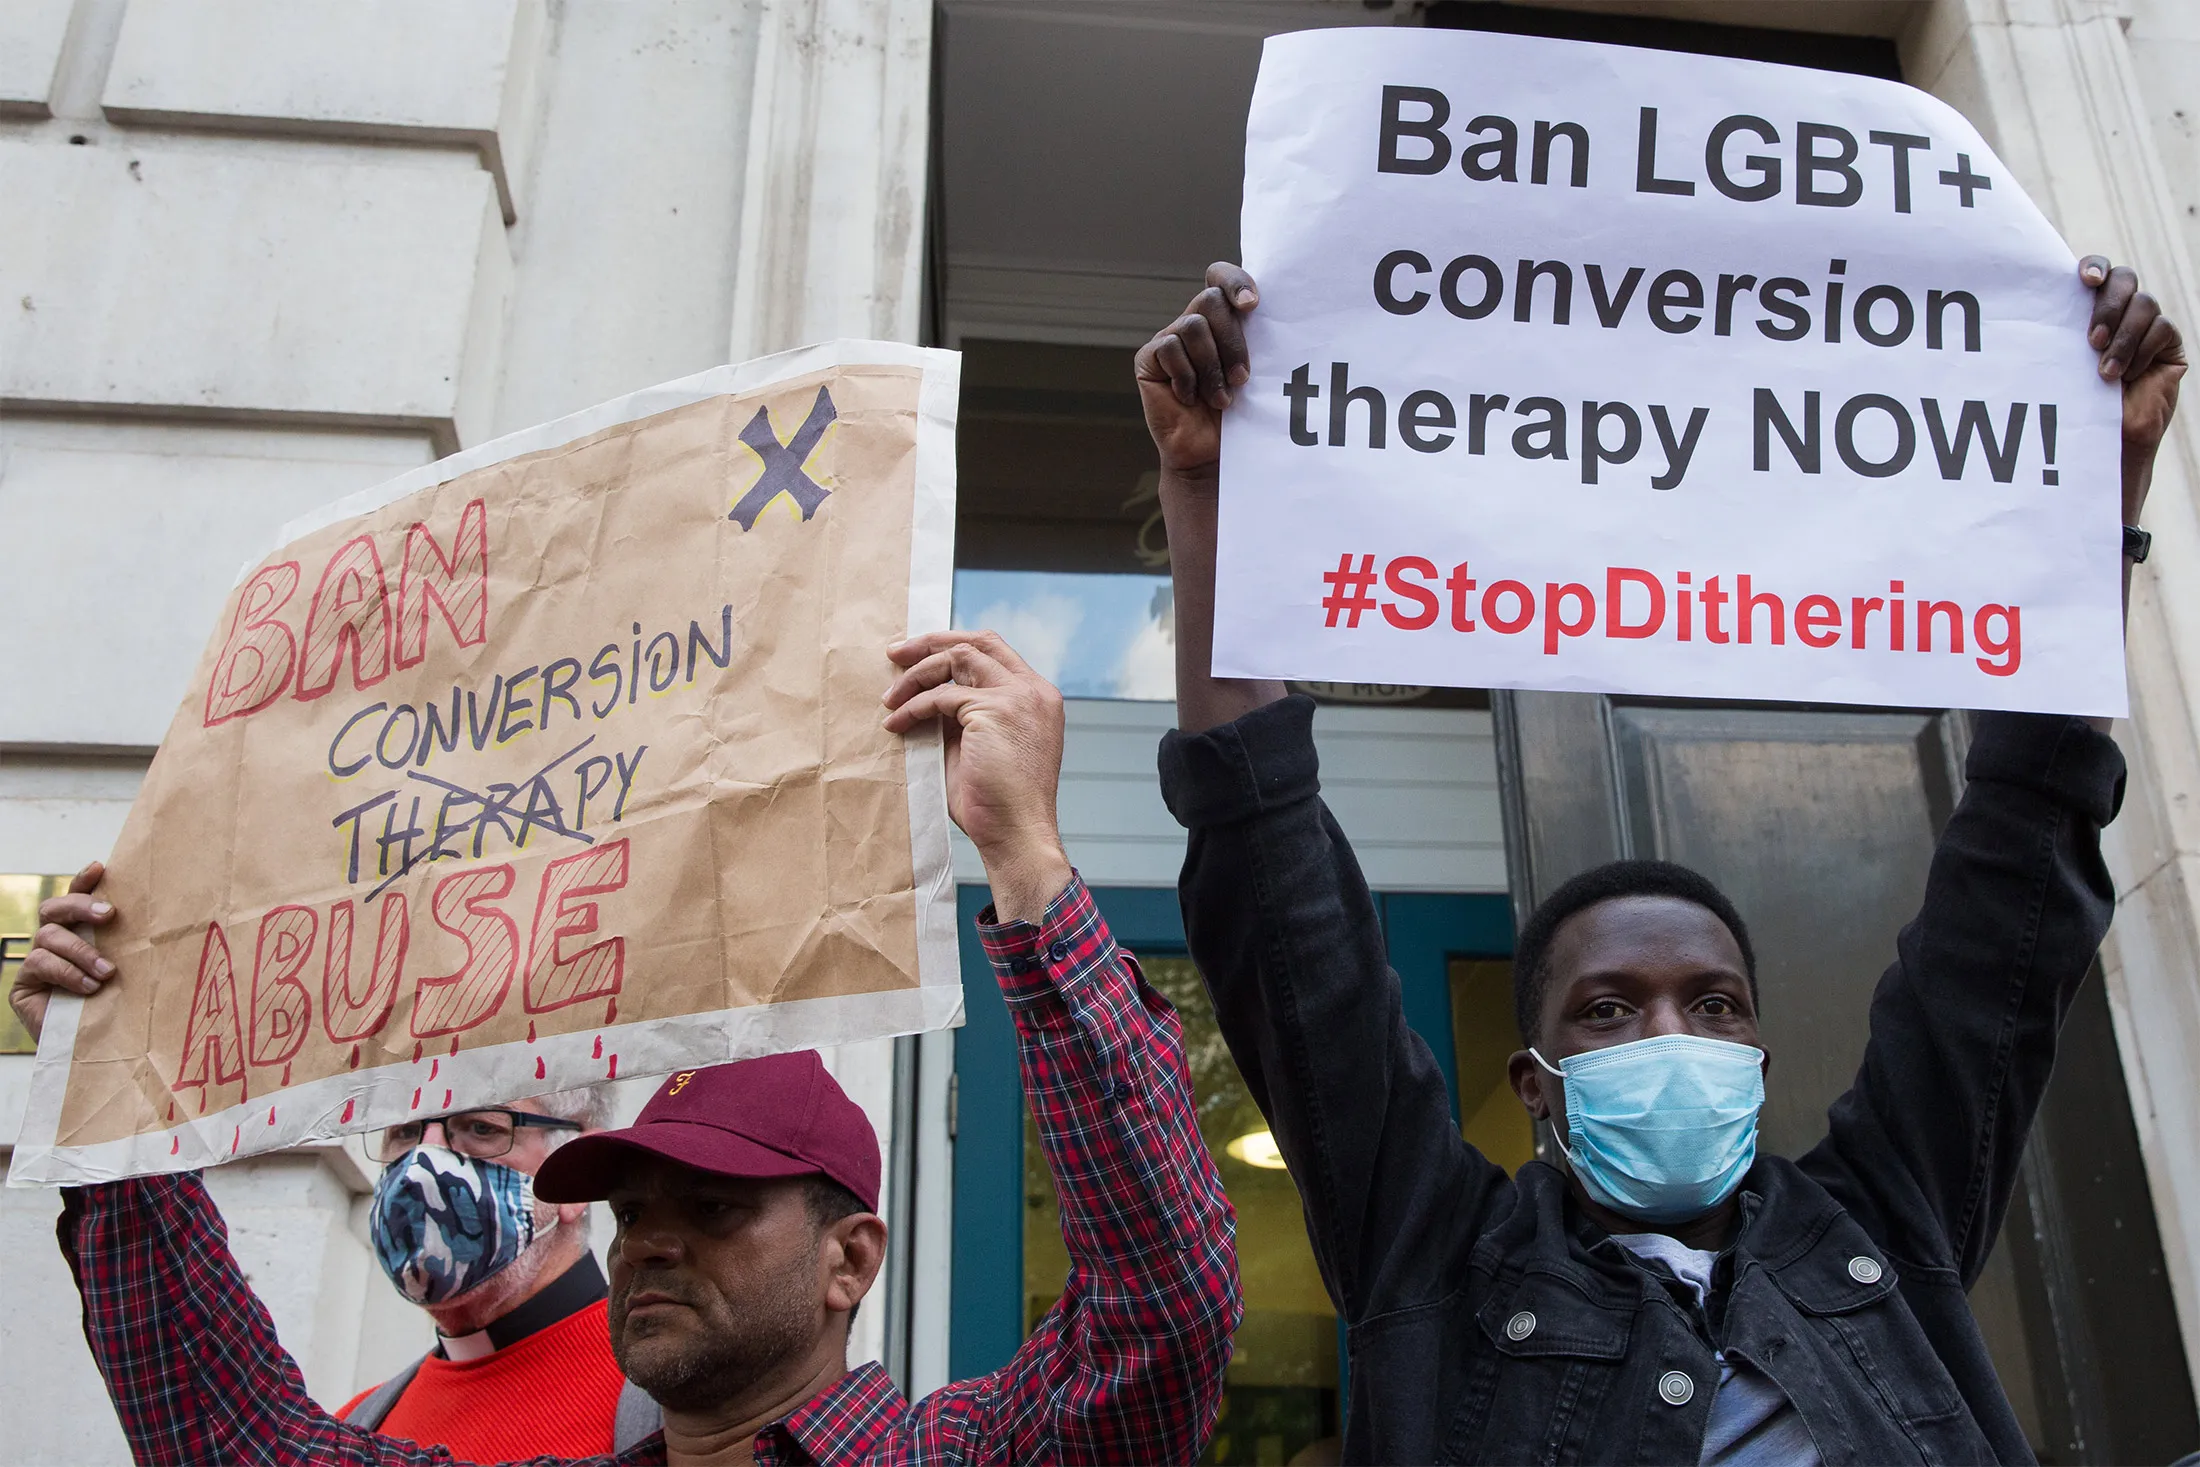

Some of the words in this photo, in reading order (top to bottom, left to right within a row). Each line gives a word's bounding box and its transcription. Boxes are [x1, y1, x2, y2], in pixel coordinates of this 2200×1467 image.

[1378, 85, 1590, 187] Ban
[1636, 107, 1992, 213] LGBT+
[1374, 250, 1981, 352] conversion
[1283, 362, 1710, 490] therapy
[1754, 388, 2060, 486] NOW!
[203, 498, 488, 728] BAN
[1323, 554, 2022, 677] #StopDithering
[332, 744, 648, 890] THERAPY
[172, 838, 630, 1090] ABUSE
